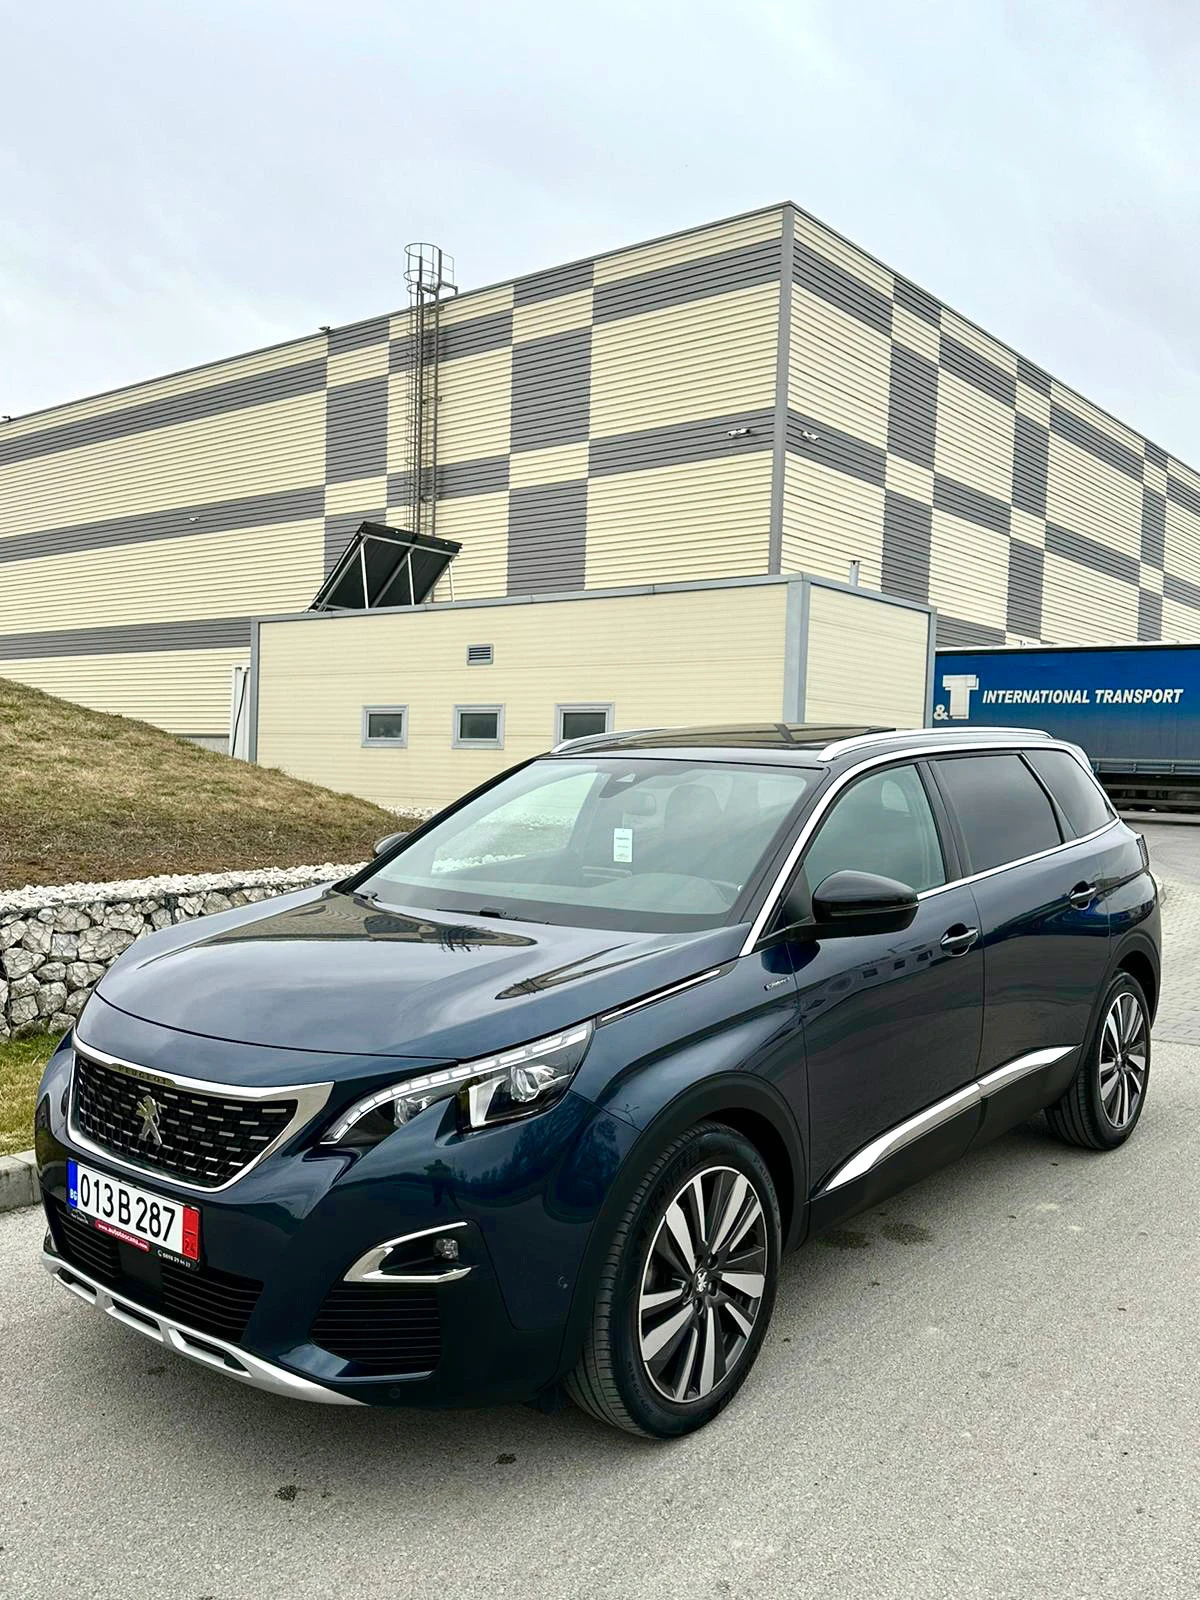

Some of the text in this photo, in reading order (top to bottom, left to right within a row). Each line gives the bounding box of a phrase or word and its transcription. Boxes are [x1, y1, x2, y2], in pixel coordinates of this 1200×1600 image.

[982, 689, 1090, 705] INTERNATIONAL
[1095, 688, 1184, 704] TRANSPORT
[69, 1187, 78, 1201] BG
